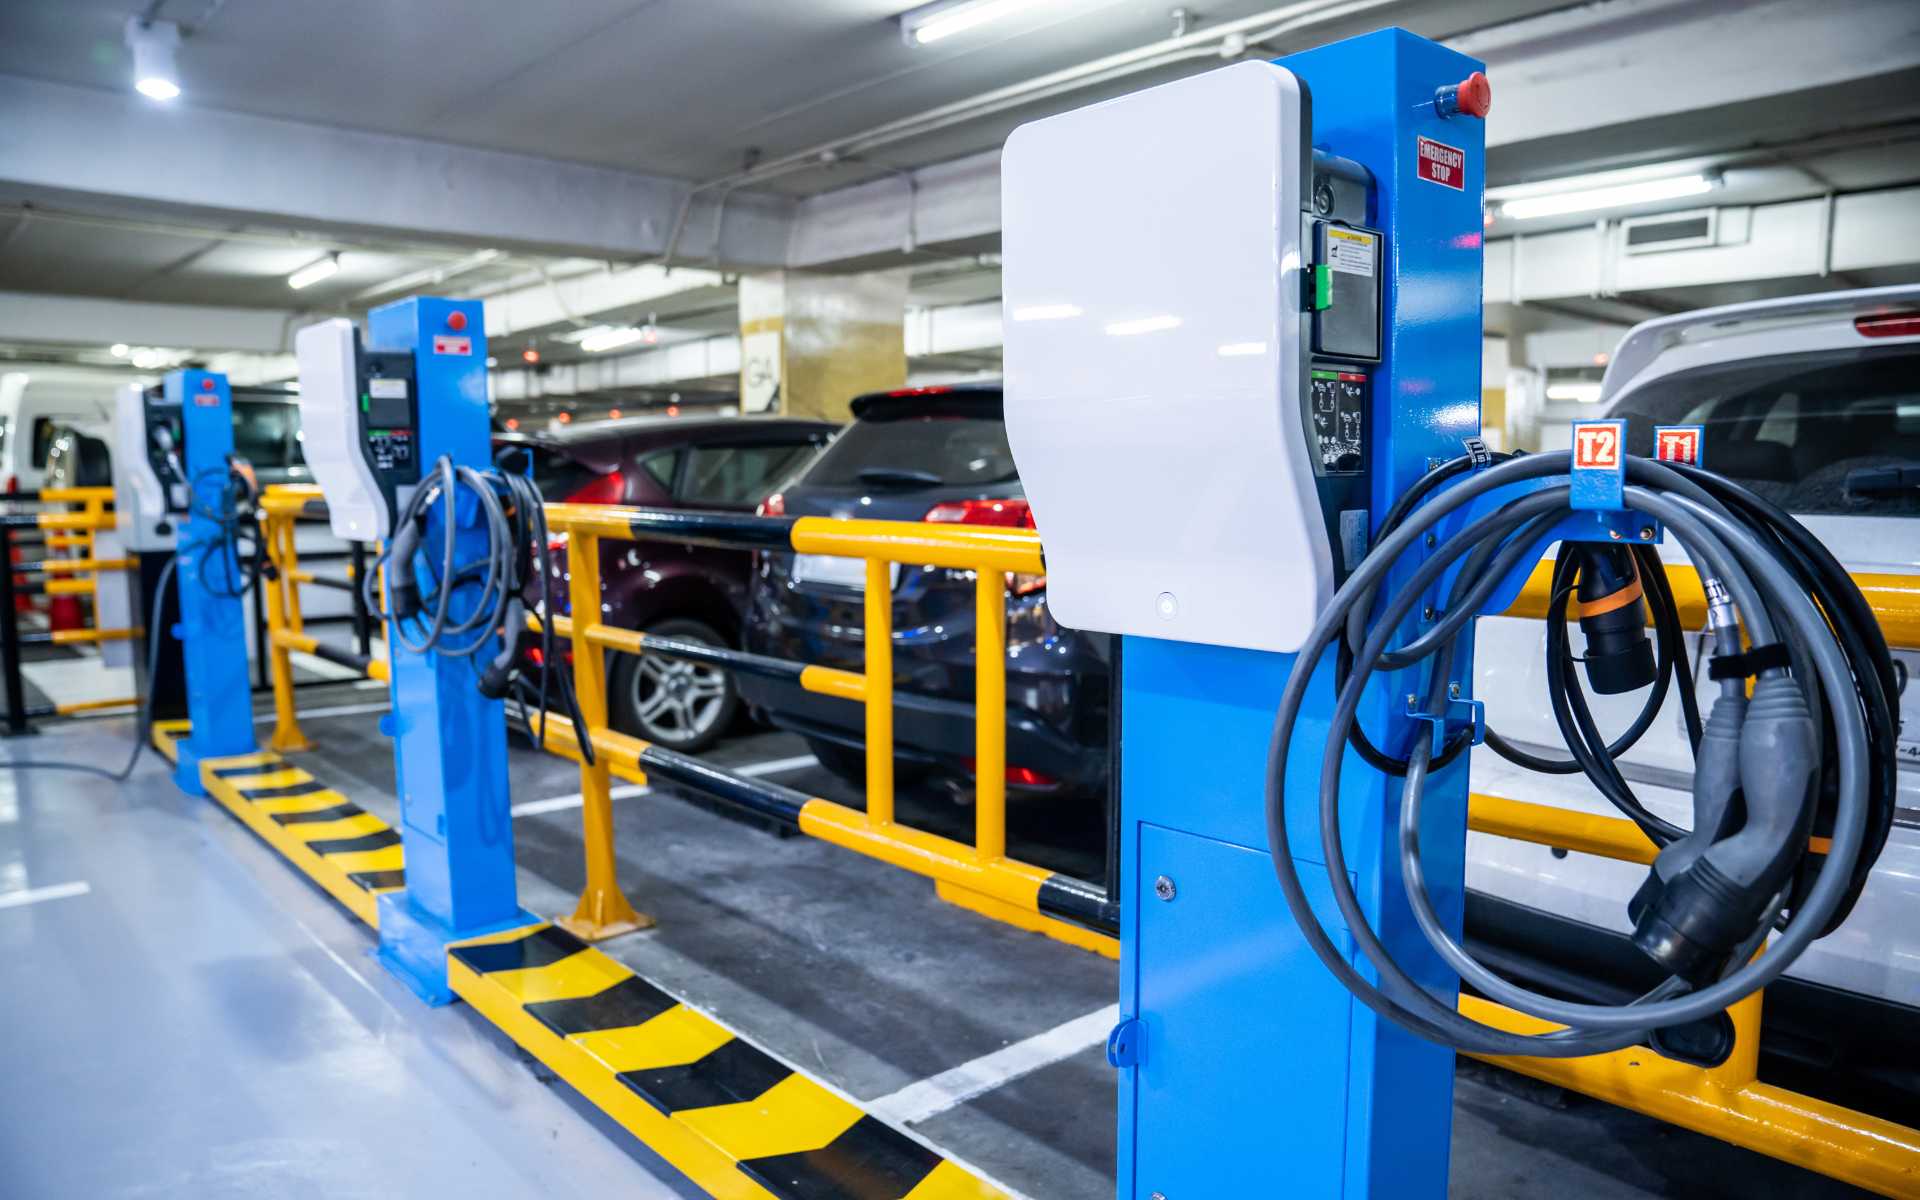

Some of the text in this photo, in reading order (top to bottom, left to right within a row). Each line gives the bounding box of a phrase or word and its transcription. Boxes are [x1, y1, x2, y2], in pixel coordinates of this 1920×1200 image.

[1420, 140, 1462, 169] EMERGENCY
[1431, 162, 1451, 182] STOP
[1579, 431, 1615, 463] T2
[1663, 435, 1692, 464] T1
